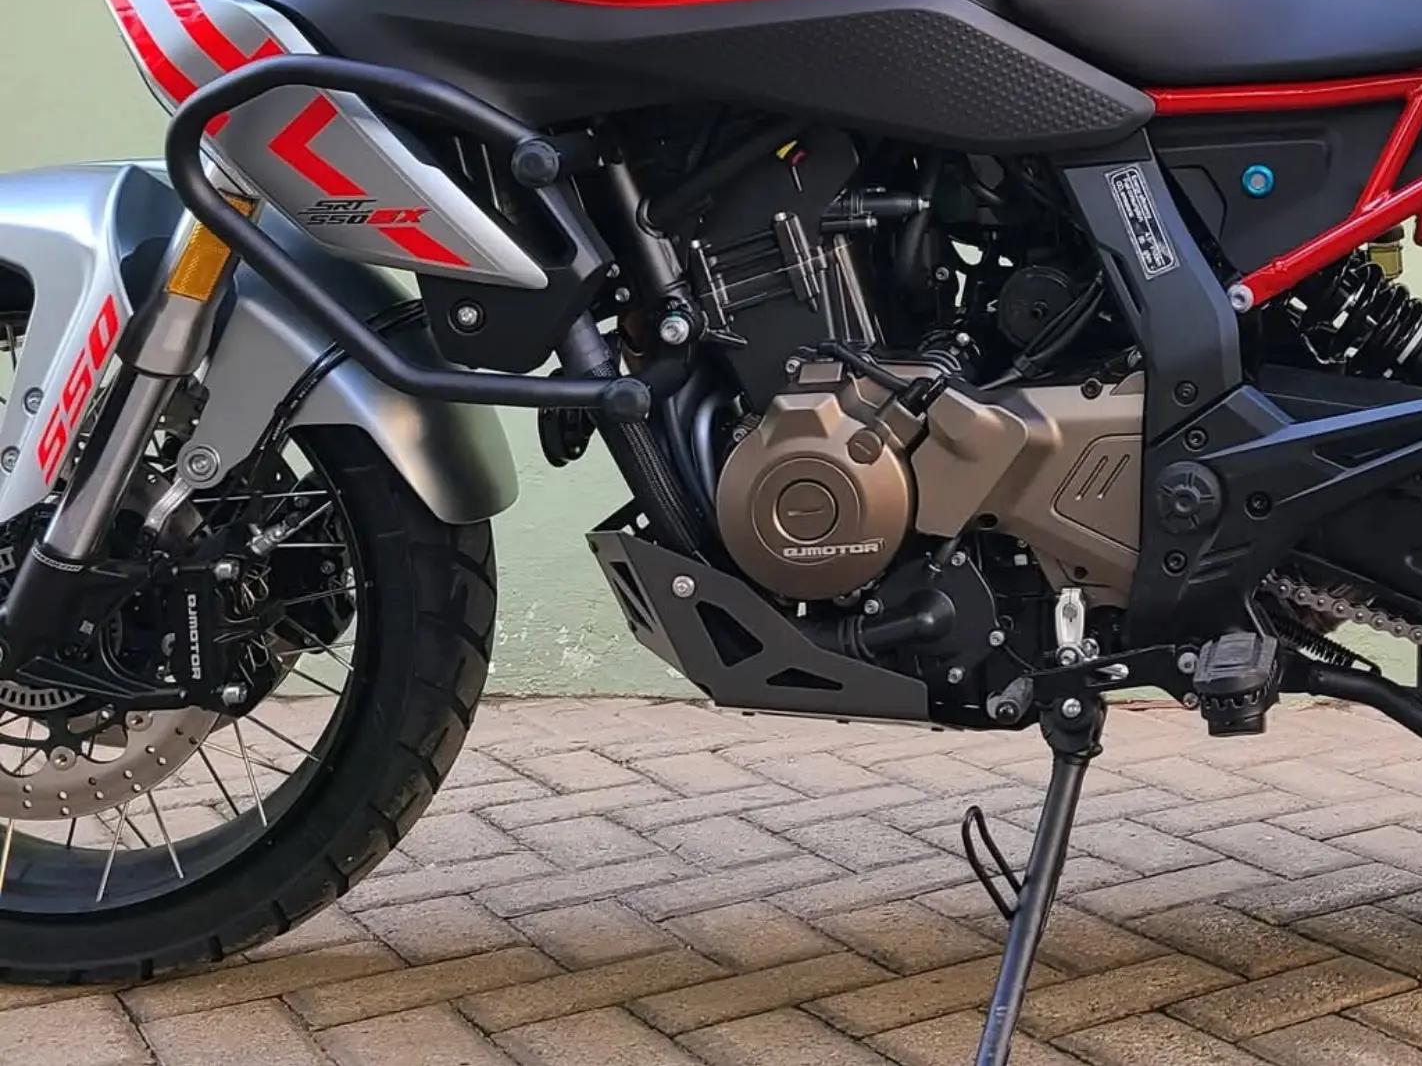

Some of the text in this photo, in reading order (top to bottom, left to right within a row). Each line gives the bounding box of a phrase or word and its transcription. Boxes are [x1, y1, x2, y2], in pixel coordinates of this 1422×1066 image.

[307, 199, 376, 211] SRT
[37, 293, 120, 487] 550
[783, 542, 879, 557] QJMOTOR
[187, 594, 201, 680] QJMOTOR
